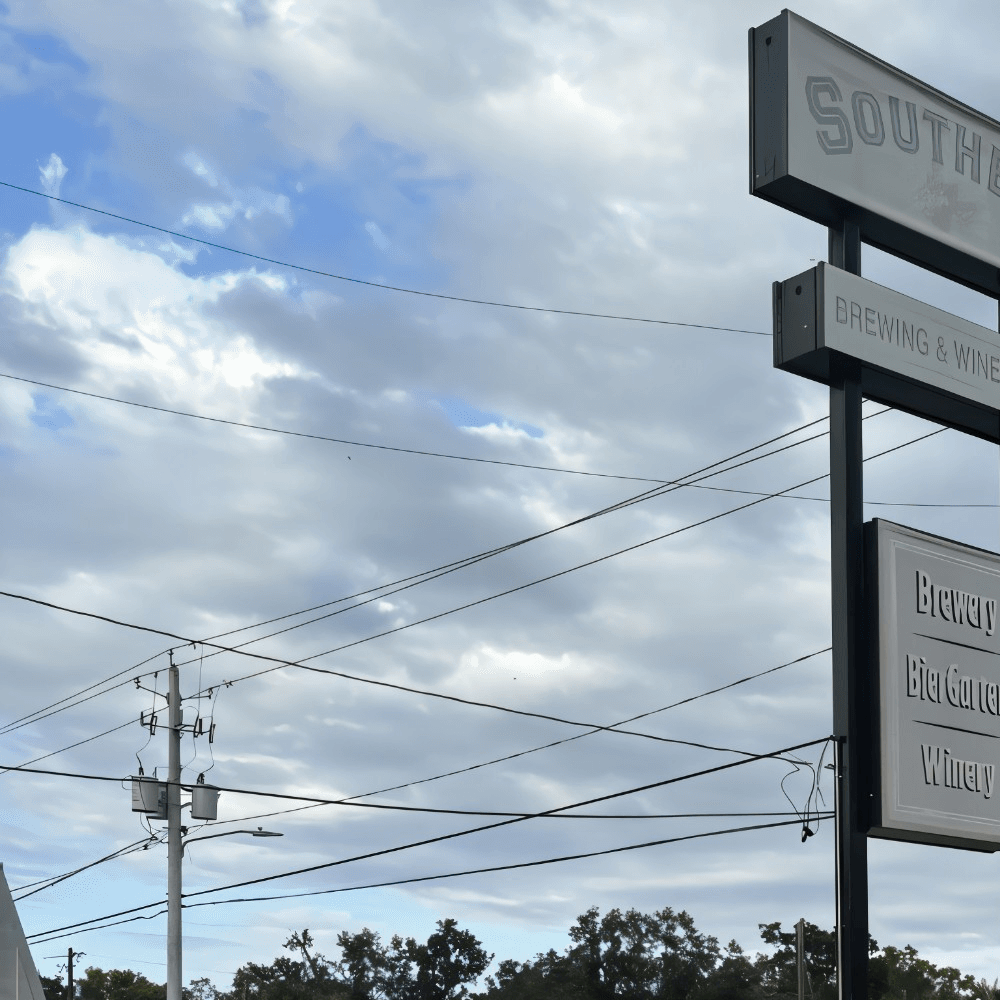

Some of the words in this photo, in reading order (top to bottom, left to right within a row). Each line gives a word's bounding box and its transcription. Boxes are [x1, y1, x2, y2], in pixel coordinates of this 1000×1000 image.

[835, 295, 930, 357] BREWING
[936, 335, 949, 365] &
[915, 569, 997, 637] Brewery
[920, 743, 996, 800] Winery
